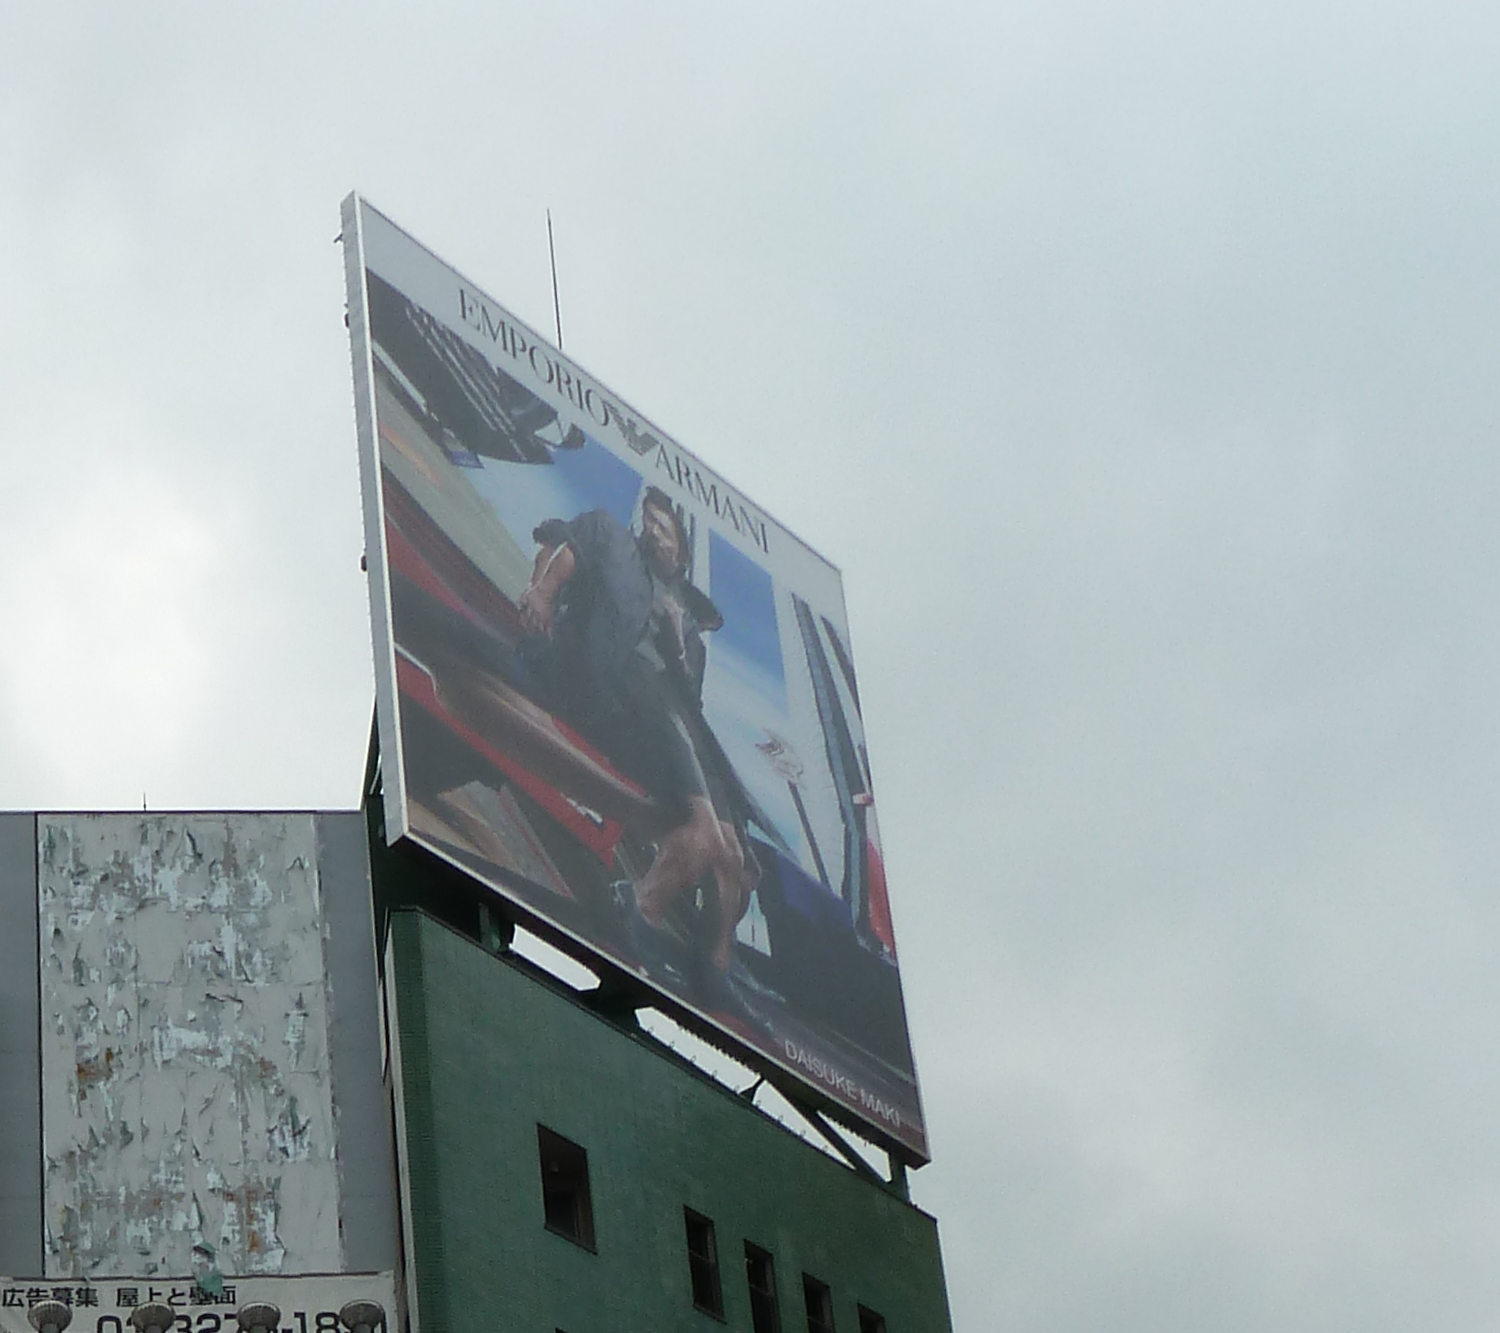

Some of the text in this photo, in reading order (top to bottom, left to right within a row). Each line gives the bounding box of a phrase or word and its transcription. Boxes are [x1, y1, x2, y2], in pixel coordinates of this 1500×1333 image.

[458, 288, 769, 554] EMPORIO ARMANI
[784, 1039, 901, 1128] DAISUKE MAKI
